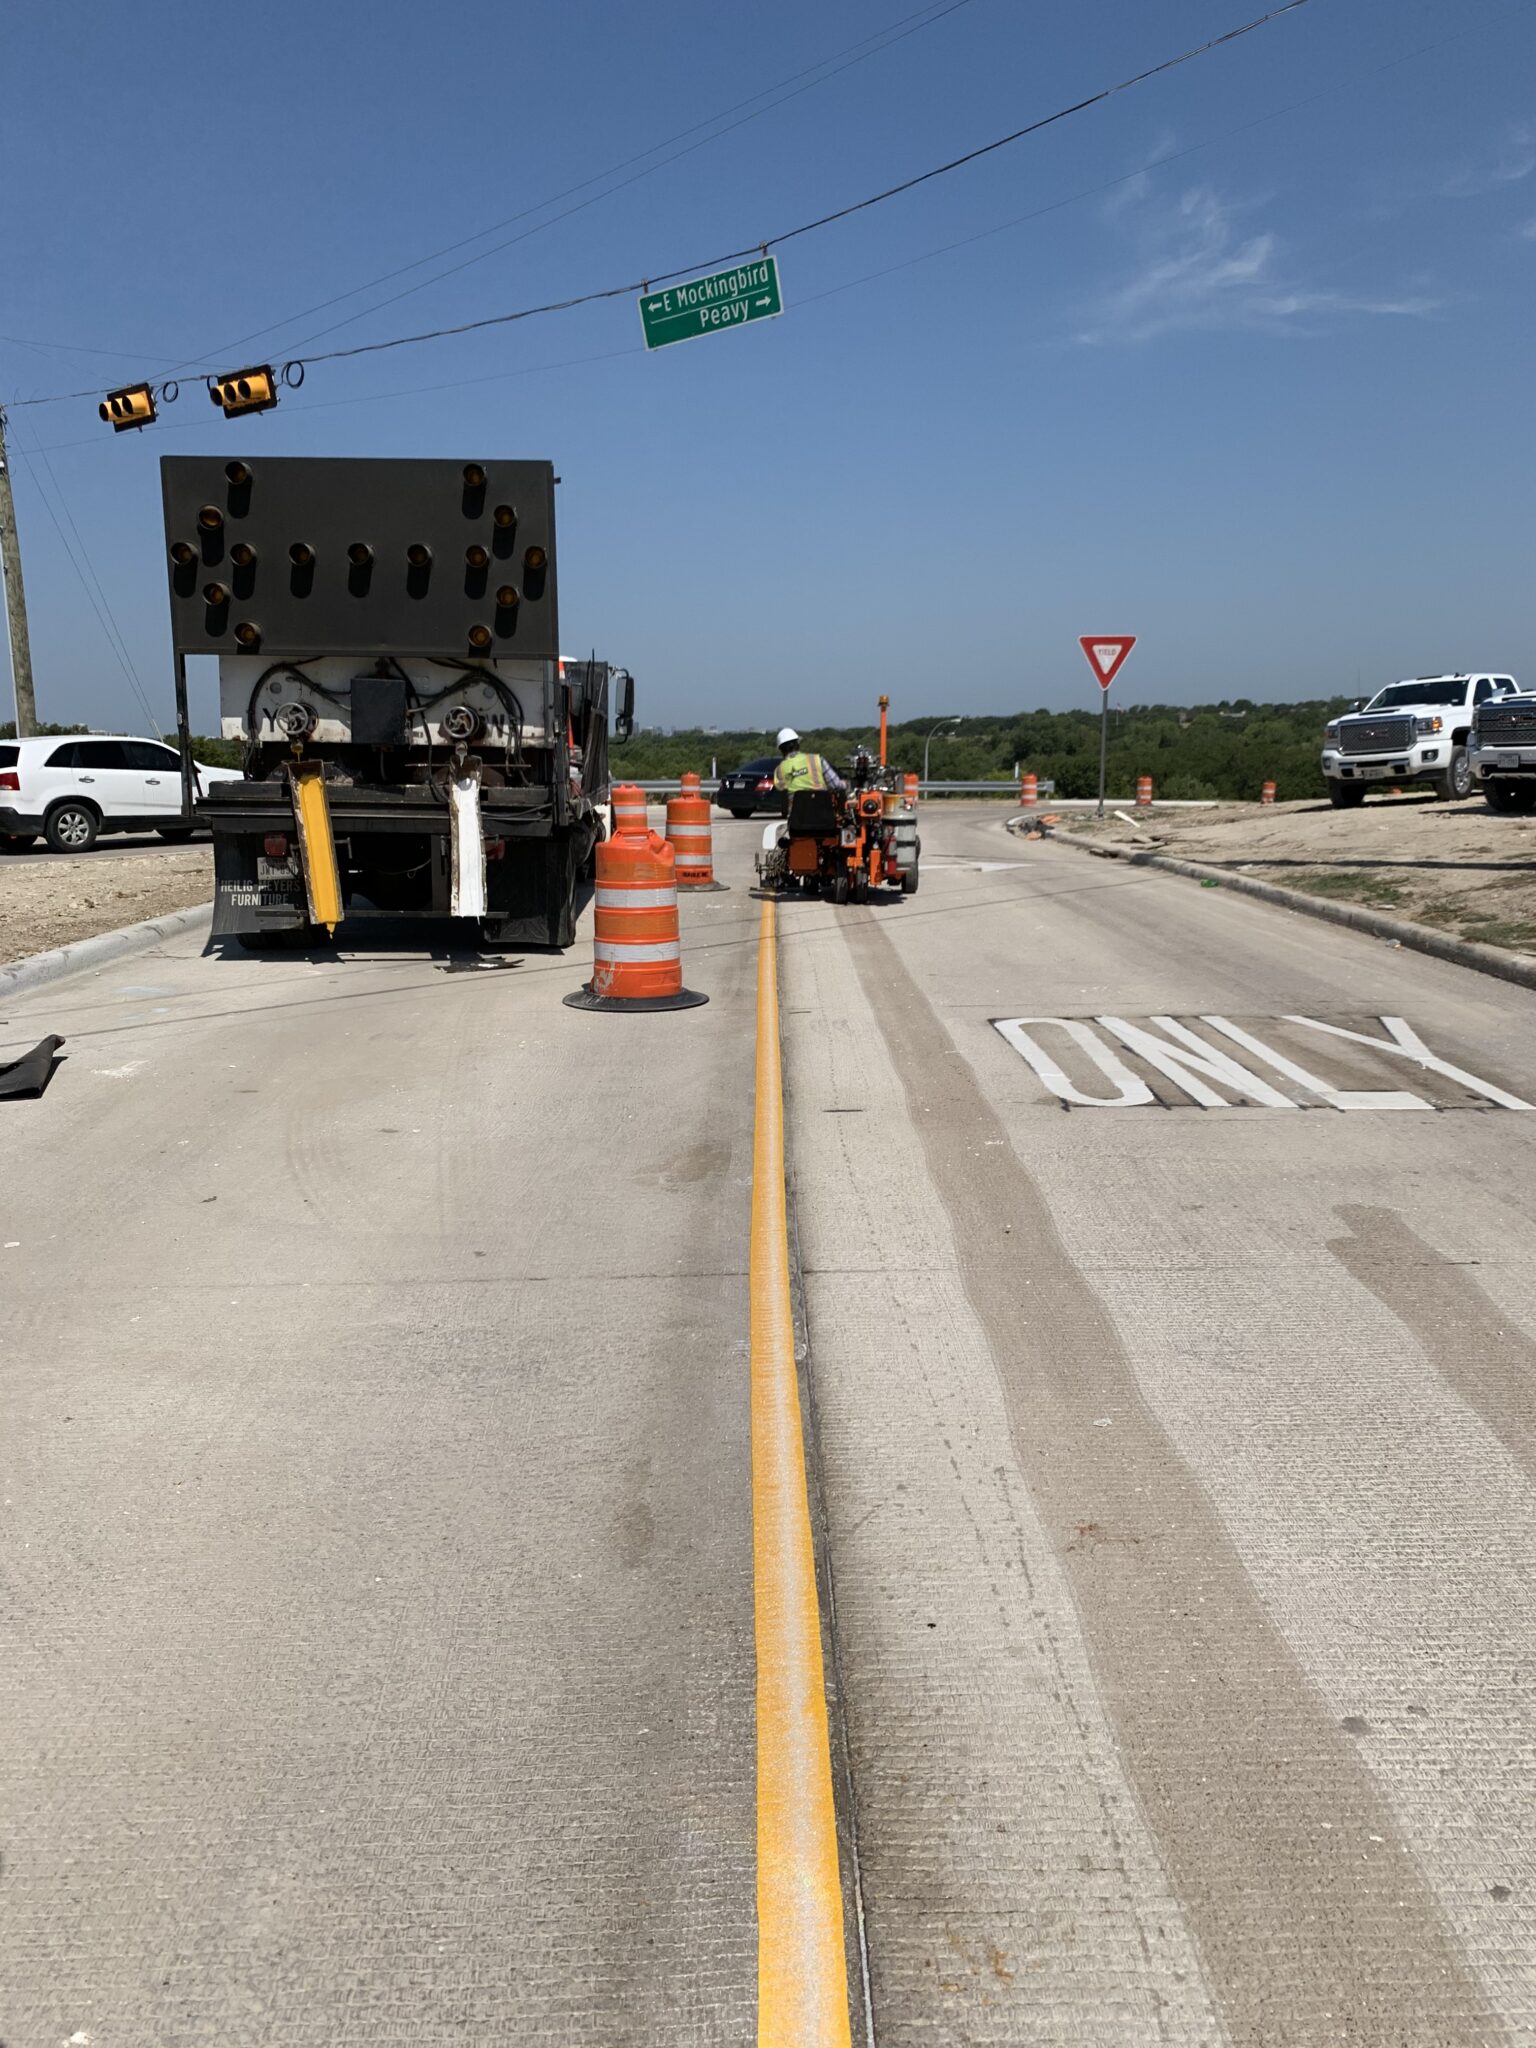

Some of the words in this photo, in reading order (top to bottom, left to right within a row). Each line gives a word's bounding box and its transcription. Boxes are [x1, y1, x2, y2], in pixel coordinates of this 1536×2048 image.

[662, 293, 672, 312] E
[676, 262, 769, 308] Mockingbird
[700, 299, 749, 328] Peavy
[231, 893, 289, 906] FURNITURE
[992, 1016, 1536, 1110] ONLY
